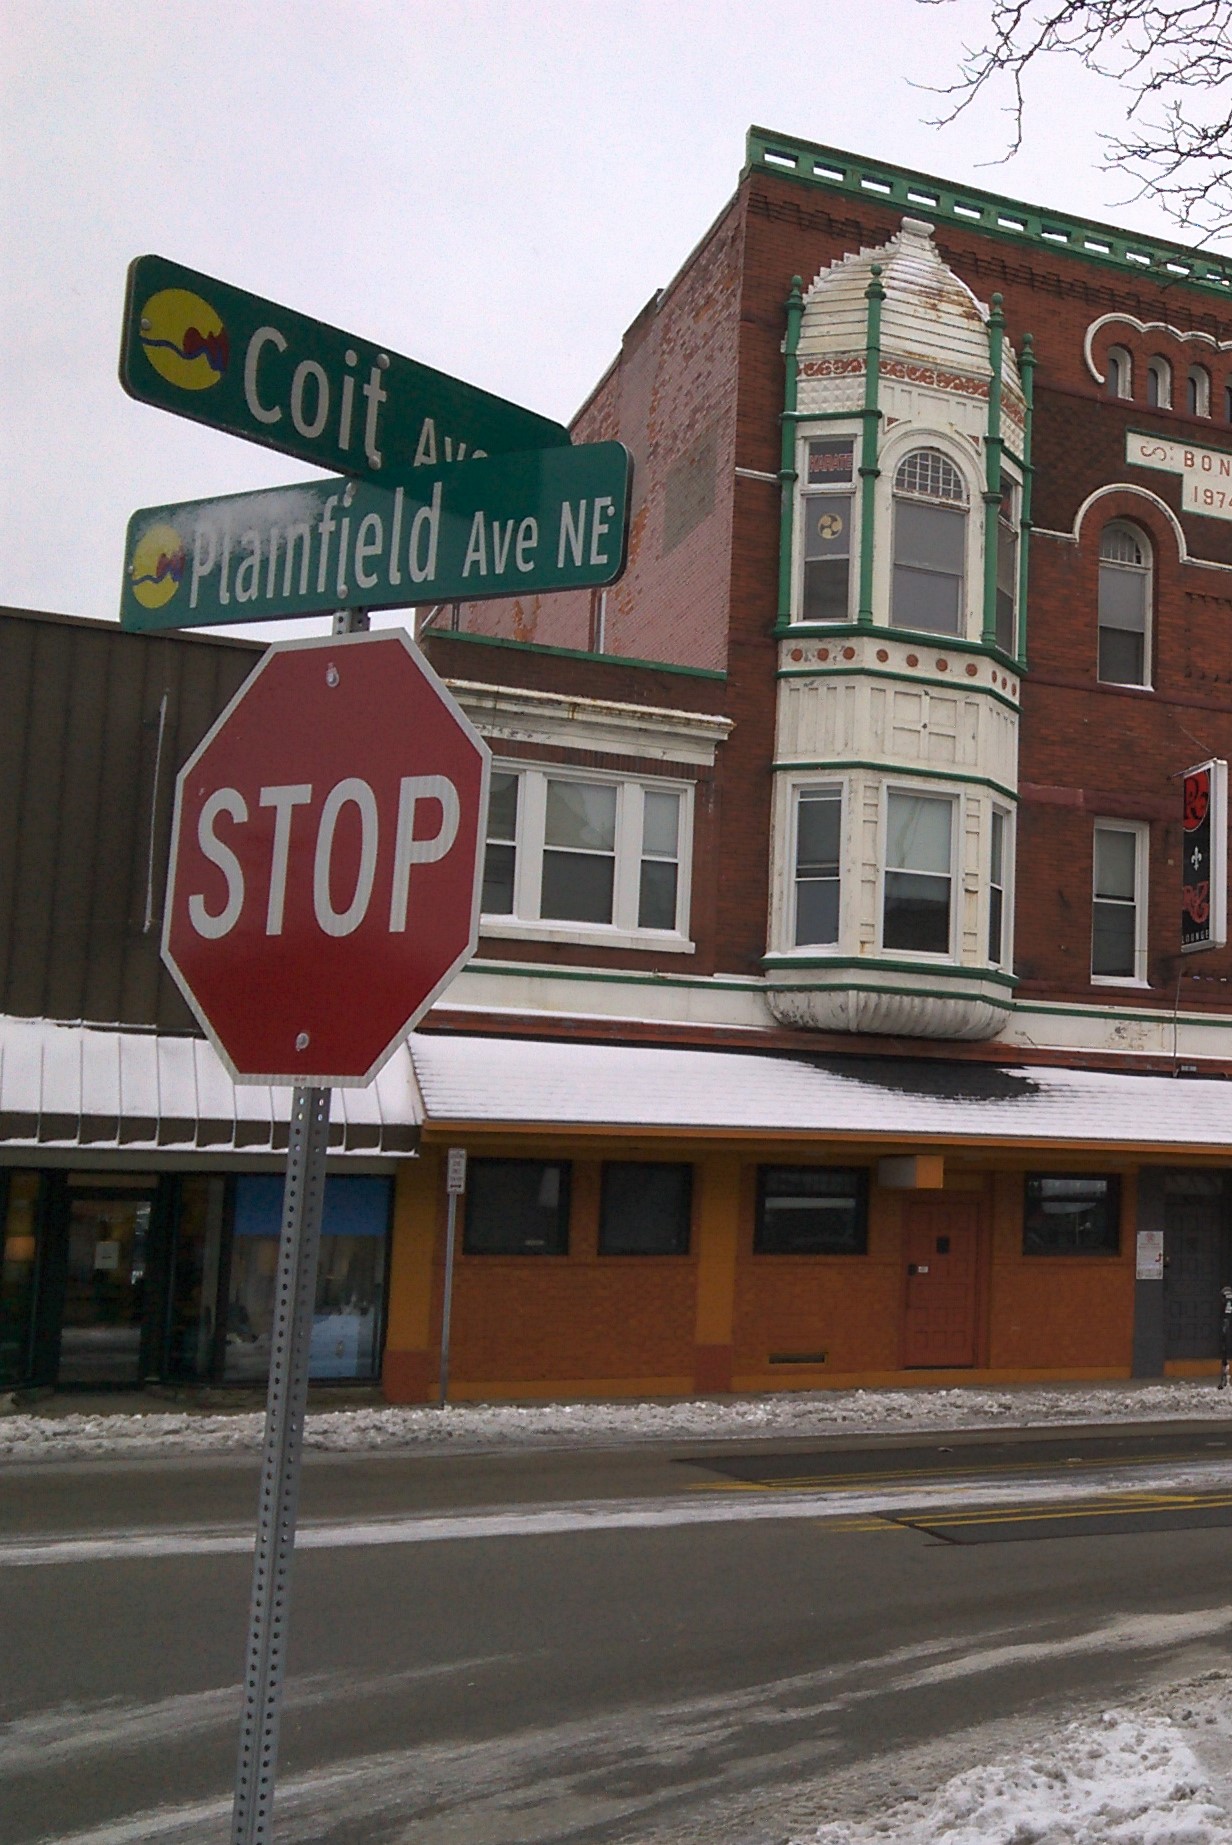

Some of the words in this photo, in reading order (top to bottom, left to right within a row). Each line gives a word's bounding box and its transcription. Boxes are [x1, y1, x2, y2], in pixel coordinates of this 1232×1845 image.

[244, 326, 388, 463] Coit
[412, 417, 489, 467] Av
[809, 453, 853, 472] KARATE
[188, 481, 443, 608] Plainfield
[462, 511, 539, 578] Ave
[557, 496, 613, 569] NE
[187, 774, 461, 939] STOP
[1181, 929, 1209, 944] LOUNGE
